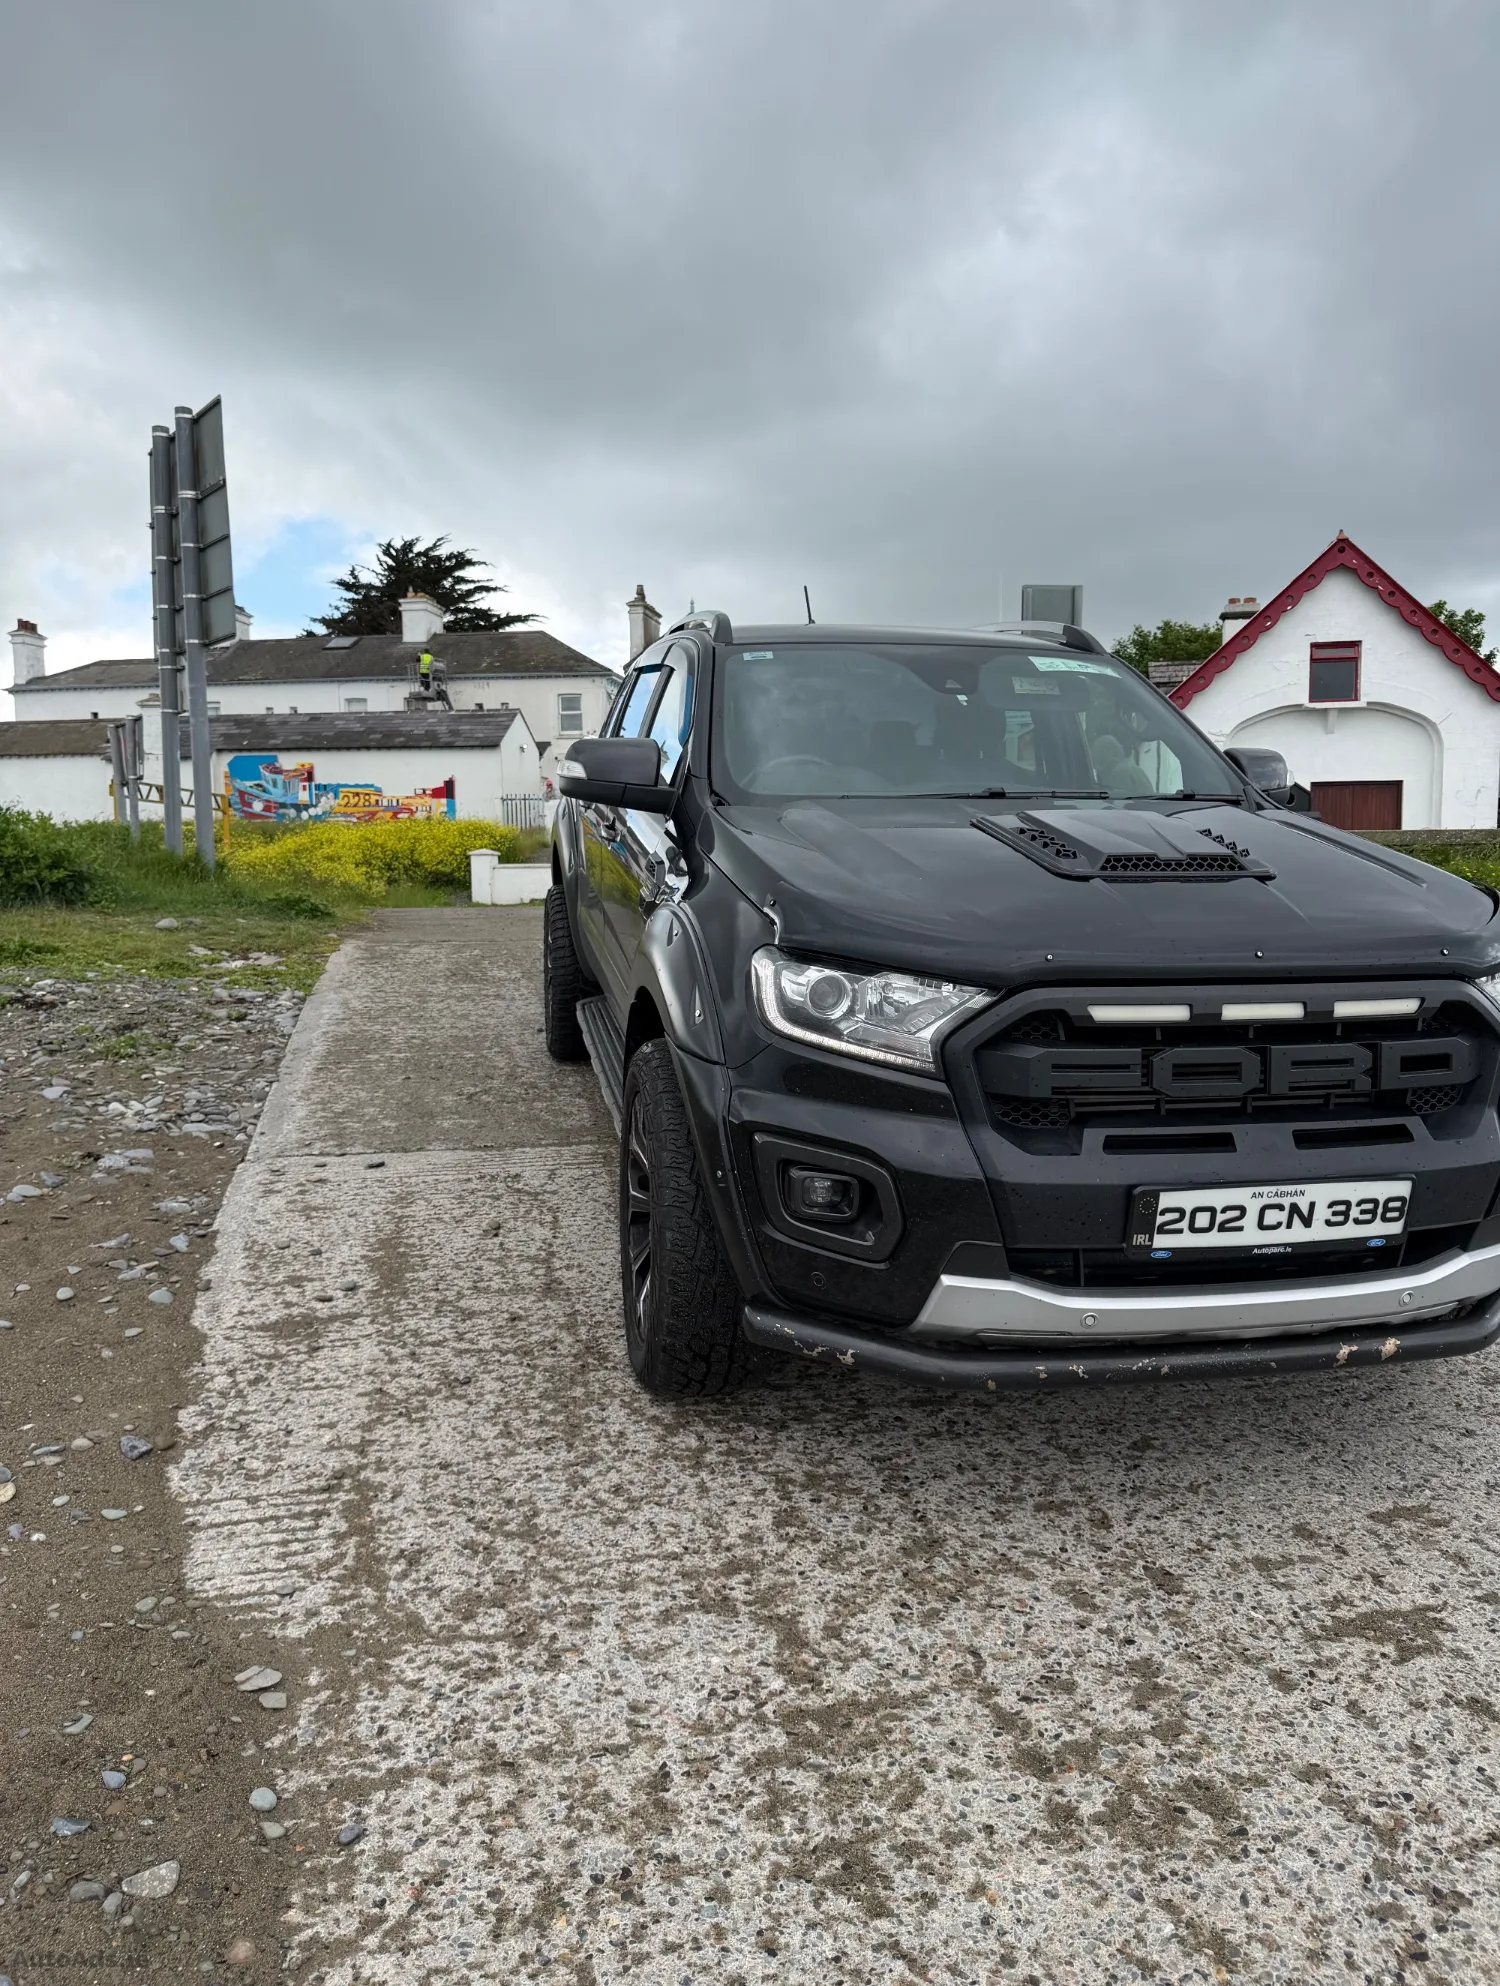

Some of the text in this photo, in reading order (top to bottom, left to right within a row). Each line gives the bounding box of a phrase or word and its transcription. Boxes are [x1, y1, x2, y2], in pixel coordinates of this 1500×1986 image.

[342, 793, 372, 807] 228
[982, 1035, 1482, 1098] FORD
[1250, 1191, 1264, 1199] AN
[1156, 1196, 1408, 1234] 202 CN 338
[1132, 1234, 1151, 1245] IRL
